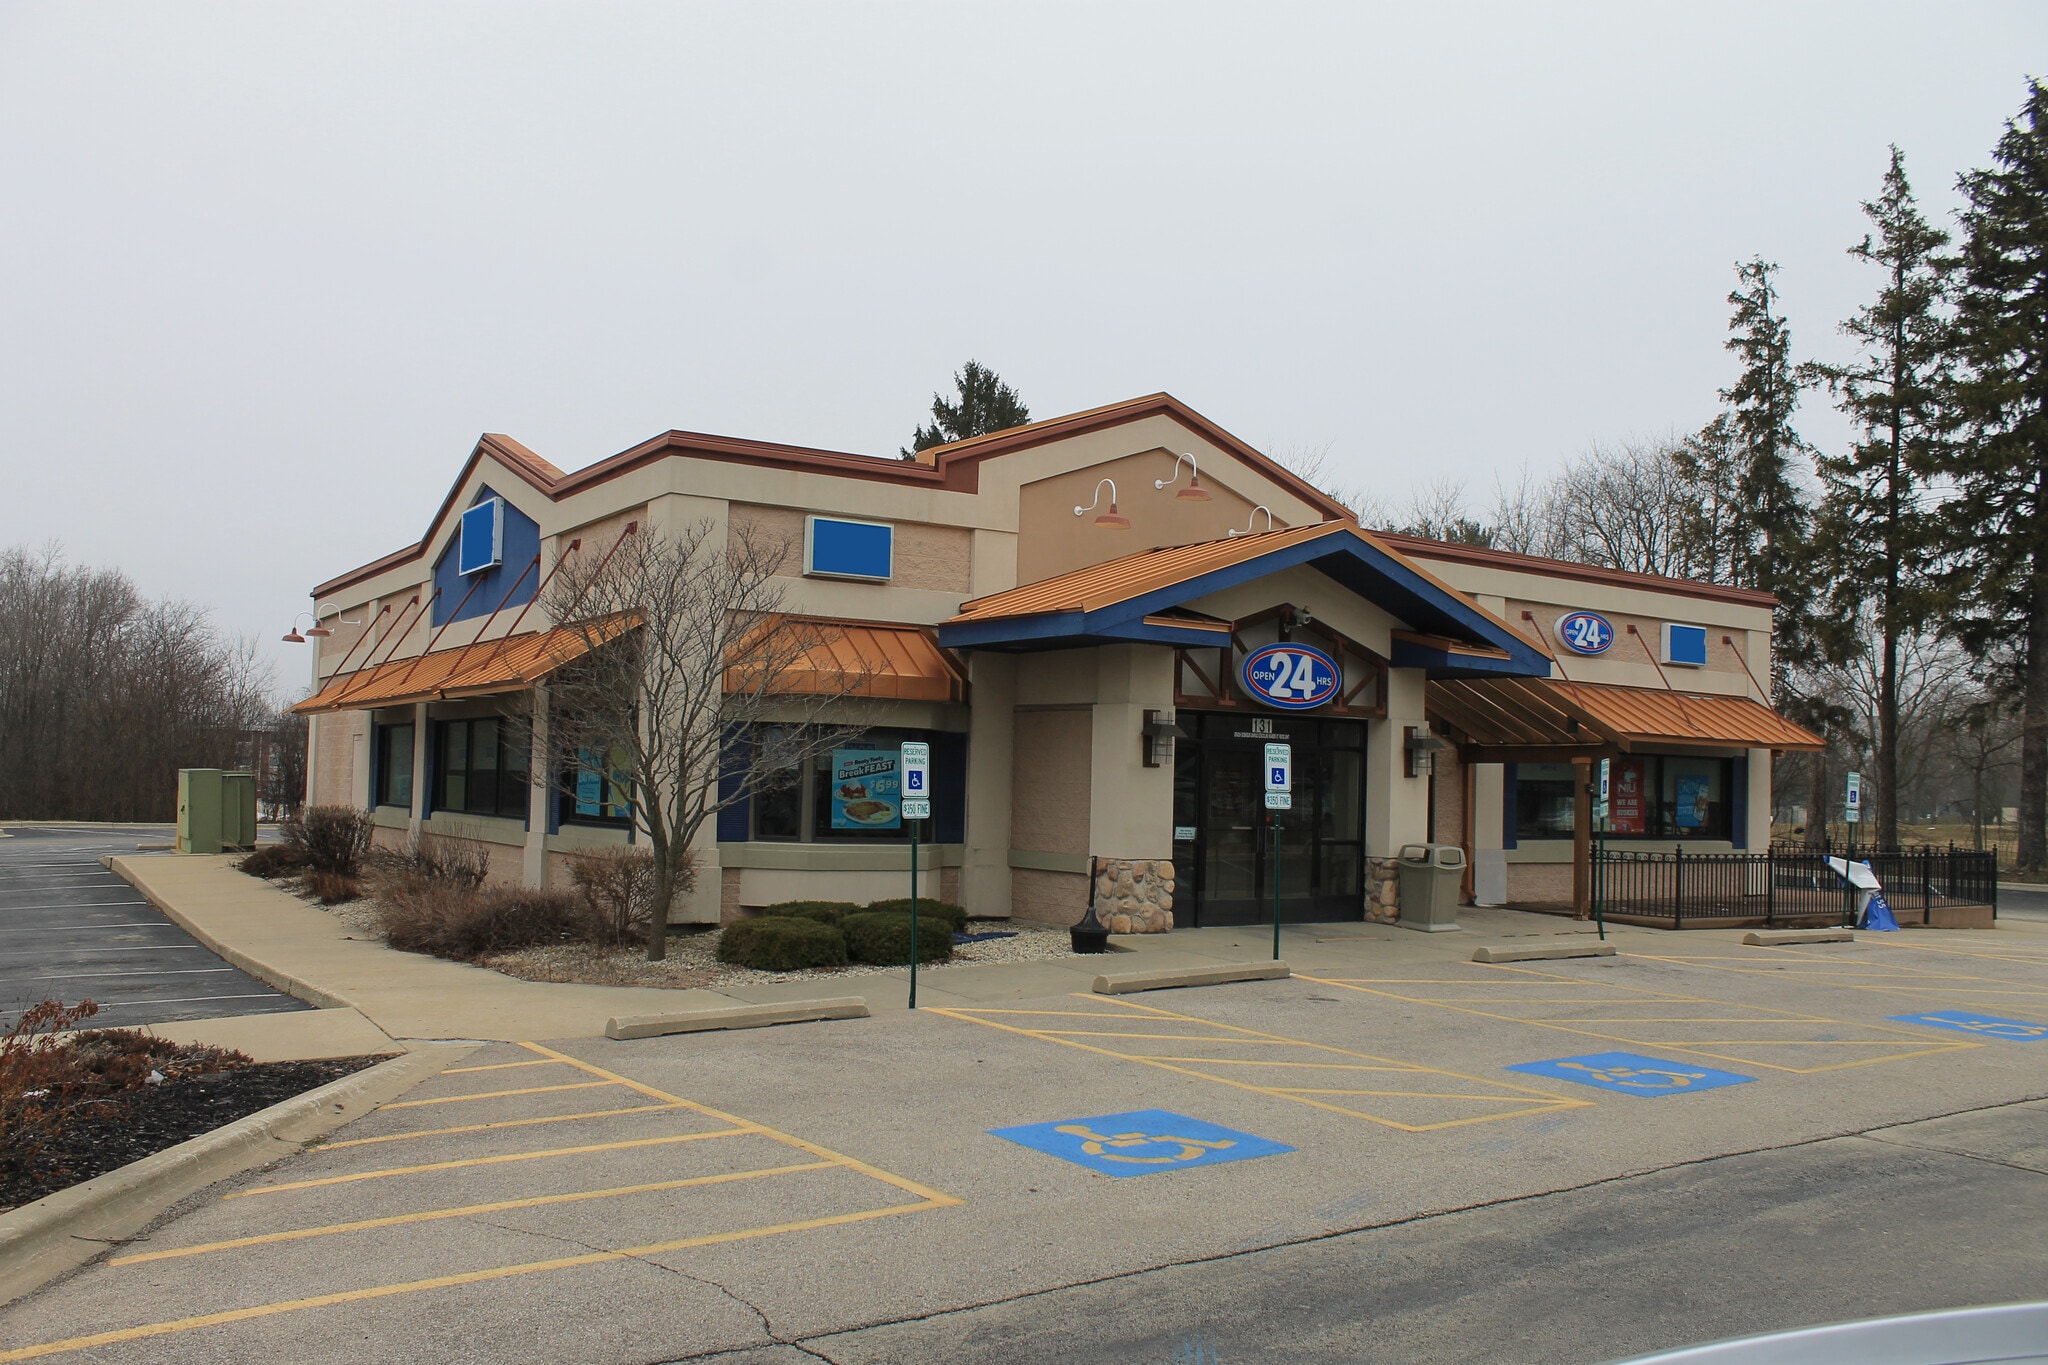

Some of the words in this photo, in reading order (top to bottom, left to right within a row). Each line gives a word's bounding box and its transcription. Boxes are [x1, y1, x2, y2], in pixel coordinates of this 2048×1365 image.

[1575, 618, 1600, 648] 24
[1253, 670, 1275, 681] OPEN
[1268, 652, 1316, 700] 24
[1316, 677, 1332, 686] HRS
[1254, 719, 1271, 732] 131
[904, 748, 927, 756] RESERVED
[1266, 748, 1289, 756] RESERVED
[905, 757, 926, 765] PARKING
[1268, 756, 1288, 764] PARKING
[839, 760, 893, 779] BreakFEAST
[1618, 783, 1636, 793] NIU
[1266, 795, 1278, 806] $350
[1280, 795, 1290, 806] FINE
[904, 803, 916, 814] $350
[917, 803, 928, 814] FINE
